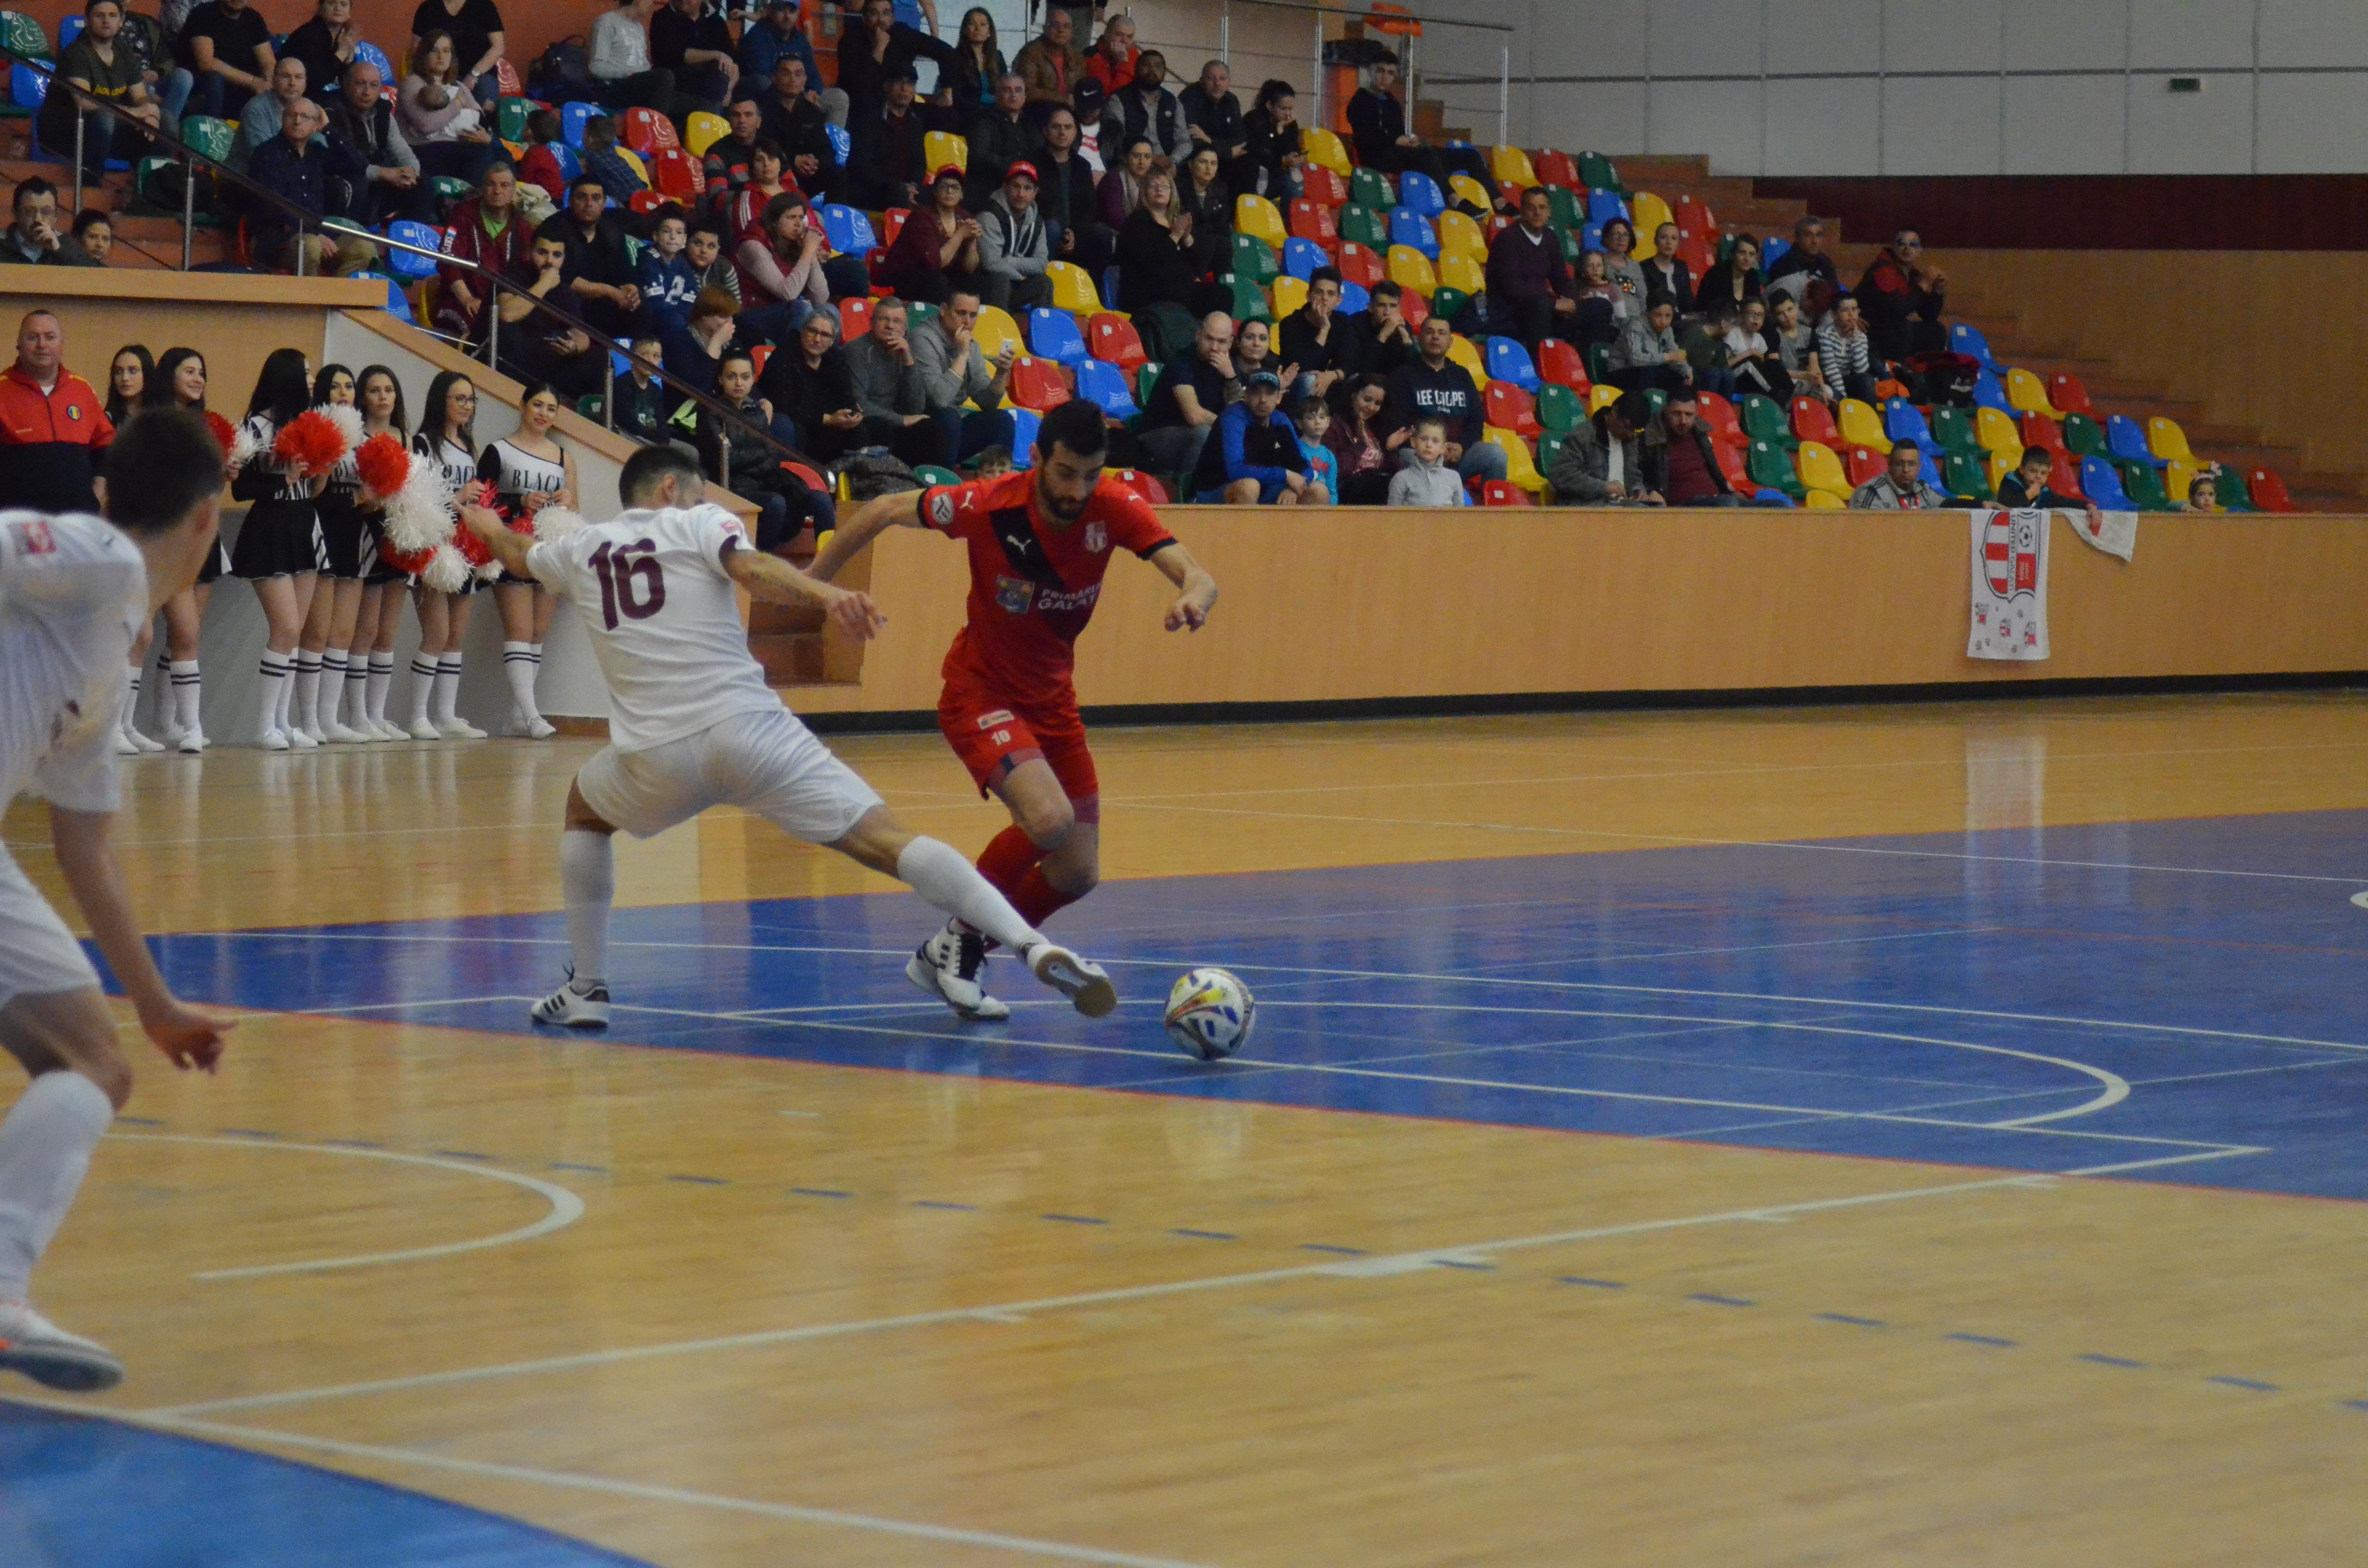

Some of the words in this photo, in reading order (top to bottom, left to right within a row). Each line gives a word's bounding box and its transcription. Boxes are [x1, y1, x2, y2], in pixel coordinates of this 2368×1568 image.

[1416, 389, 1433, 405] LEE
[588, 538, 666, 632] 16
[1038, 595, 1095, 610] GALAT
[991, 730, 1011, 746] 10
